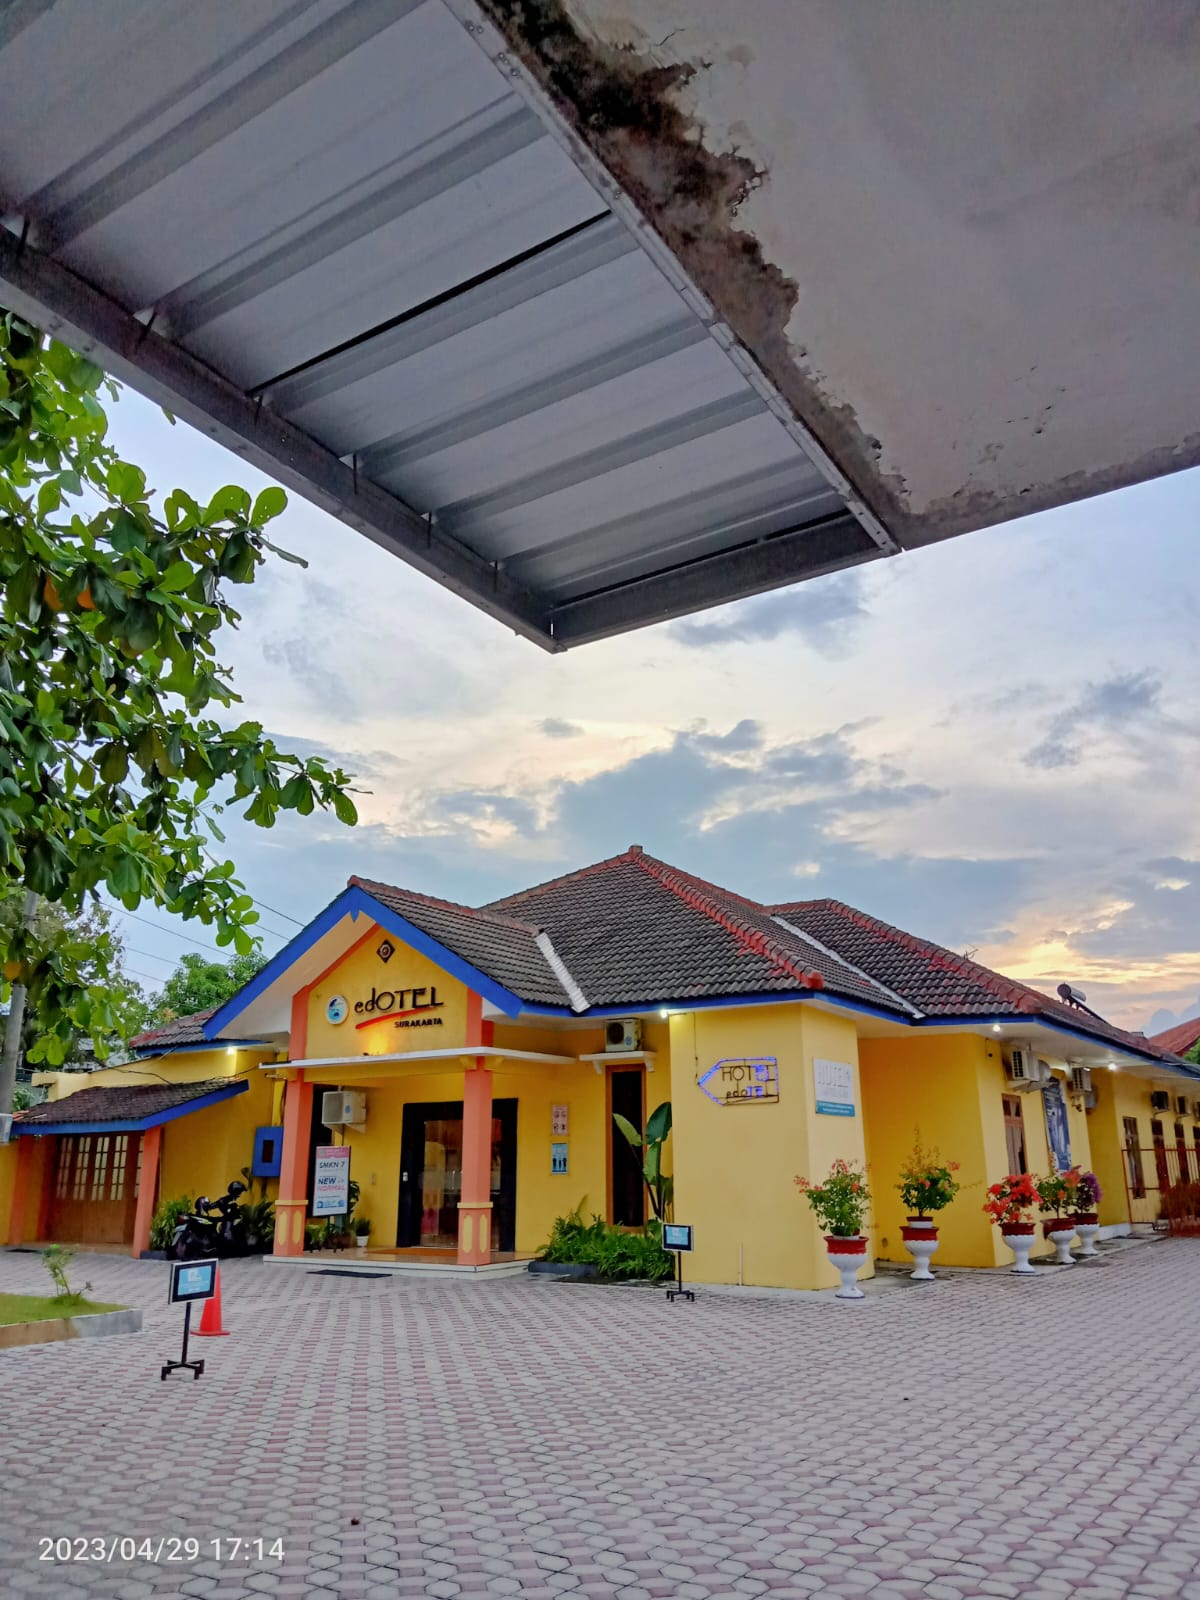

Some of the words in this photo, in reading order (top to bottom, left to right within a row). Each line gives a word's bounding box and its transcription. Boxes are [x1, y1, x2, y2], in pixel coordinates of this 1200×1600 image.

[354, 986, 444, 1014] edOTEL
[394, 1018, 443, 1029] SURAKARTA
[317, 1177, 337, 1185] NEW
